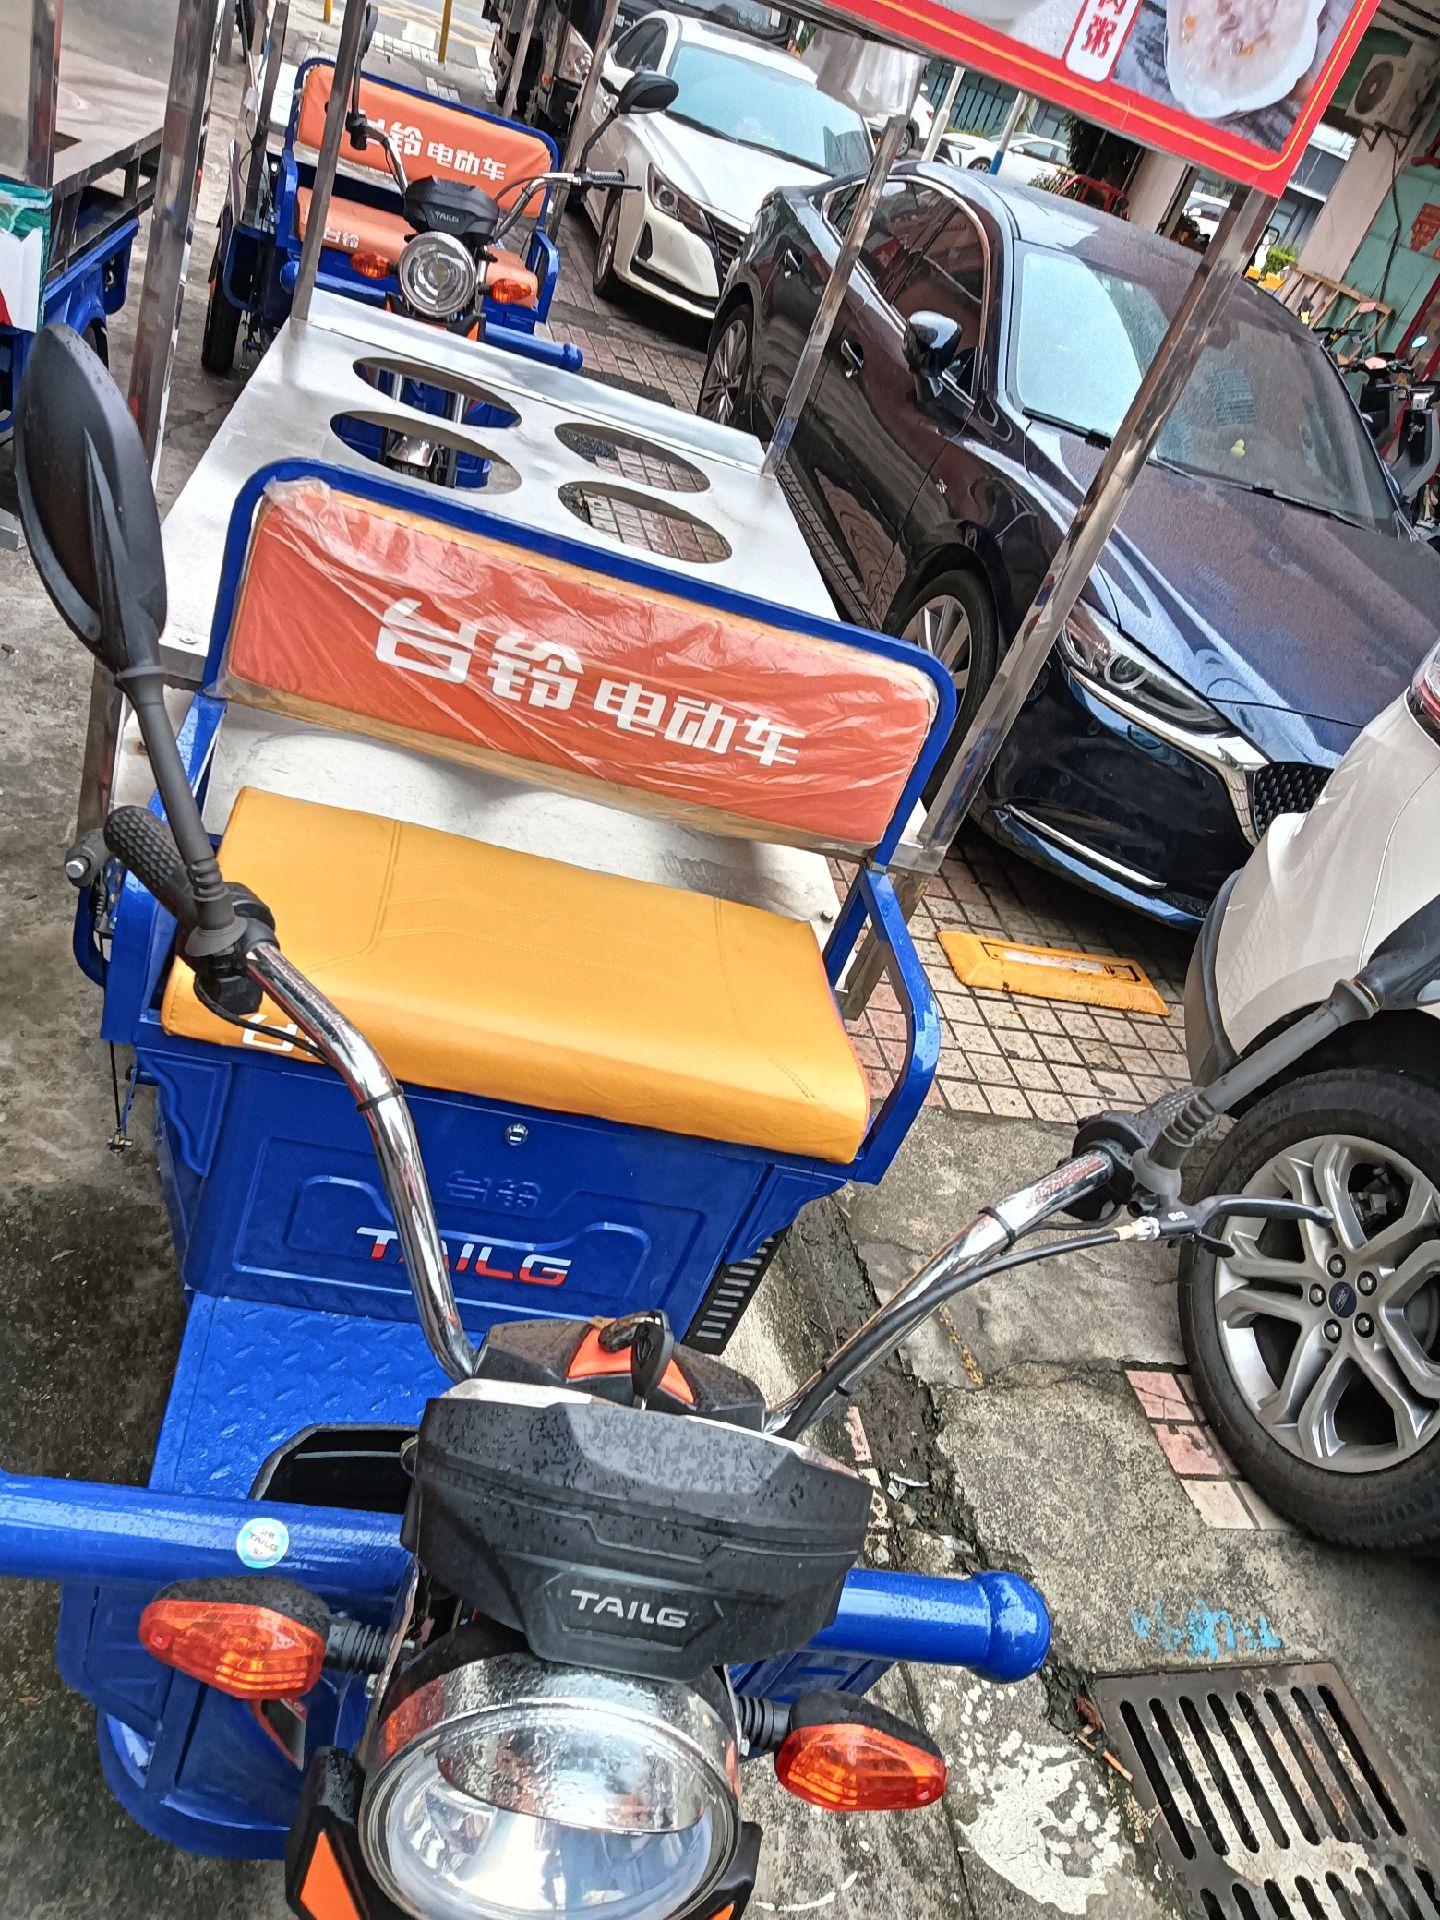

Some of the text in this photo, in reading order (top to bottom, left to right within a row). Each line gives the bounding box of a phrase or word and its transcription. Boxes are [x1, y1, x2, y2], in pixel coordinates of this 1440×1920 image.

[374, 598, 806, 767] 台铃电动车
[570, 1589, 690, 1629] TAILG
